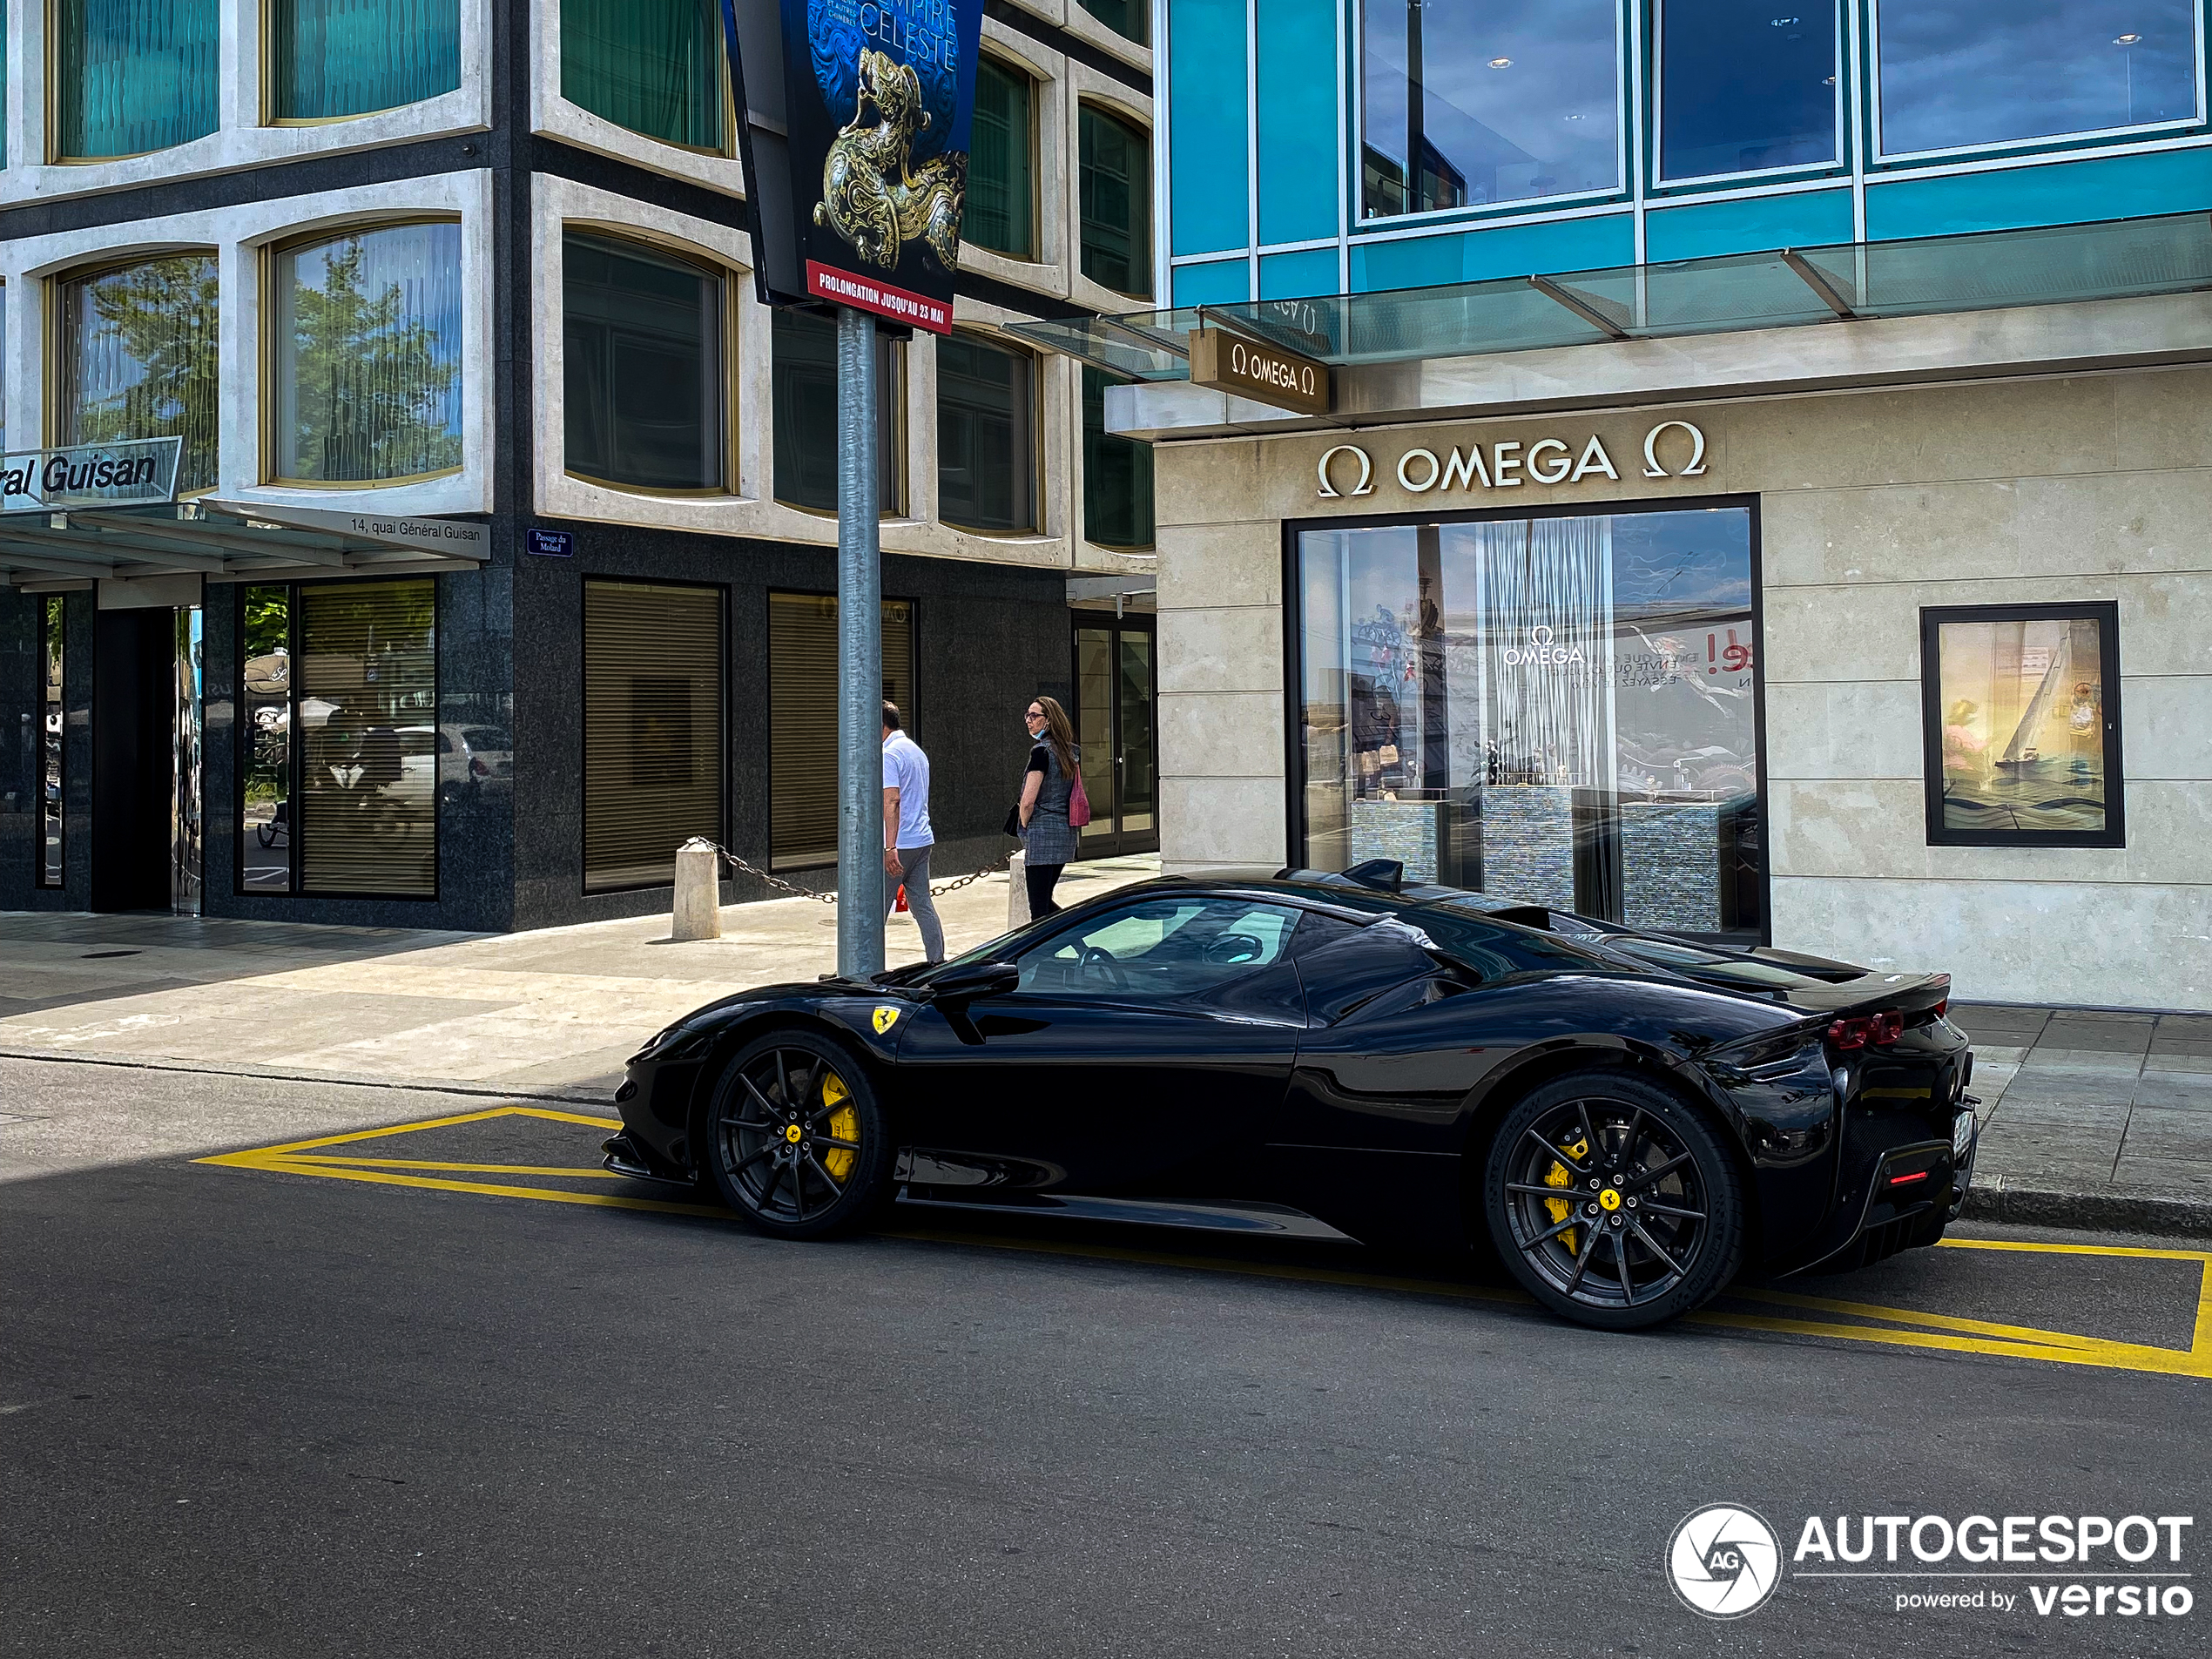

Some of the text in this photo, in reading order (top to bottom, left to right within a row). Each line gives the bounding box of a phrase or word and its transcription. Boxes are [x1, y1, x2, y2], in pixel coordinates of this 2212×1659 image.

[878, 0, 957, 37] PIRE
[860, 3, 955, 72] CELESTE
[819, 273, 944, 325] PROLONGATION JUSQU'AU 23 MAI
[1251, 354, 1298, 391] OMEGA
[43, 454, 155, 492] Guisan
[1396, 434, 1621, 493] OMEGA
[351, 518, 480, 541] 14, quai Général Guisan
[1503, 646, 1586, 665] OMEGA
